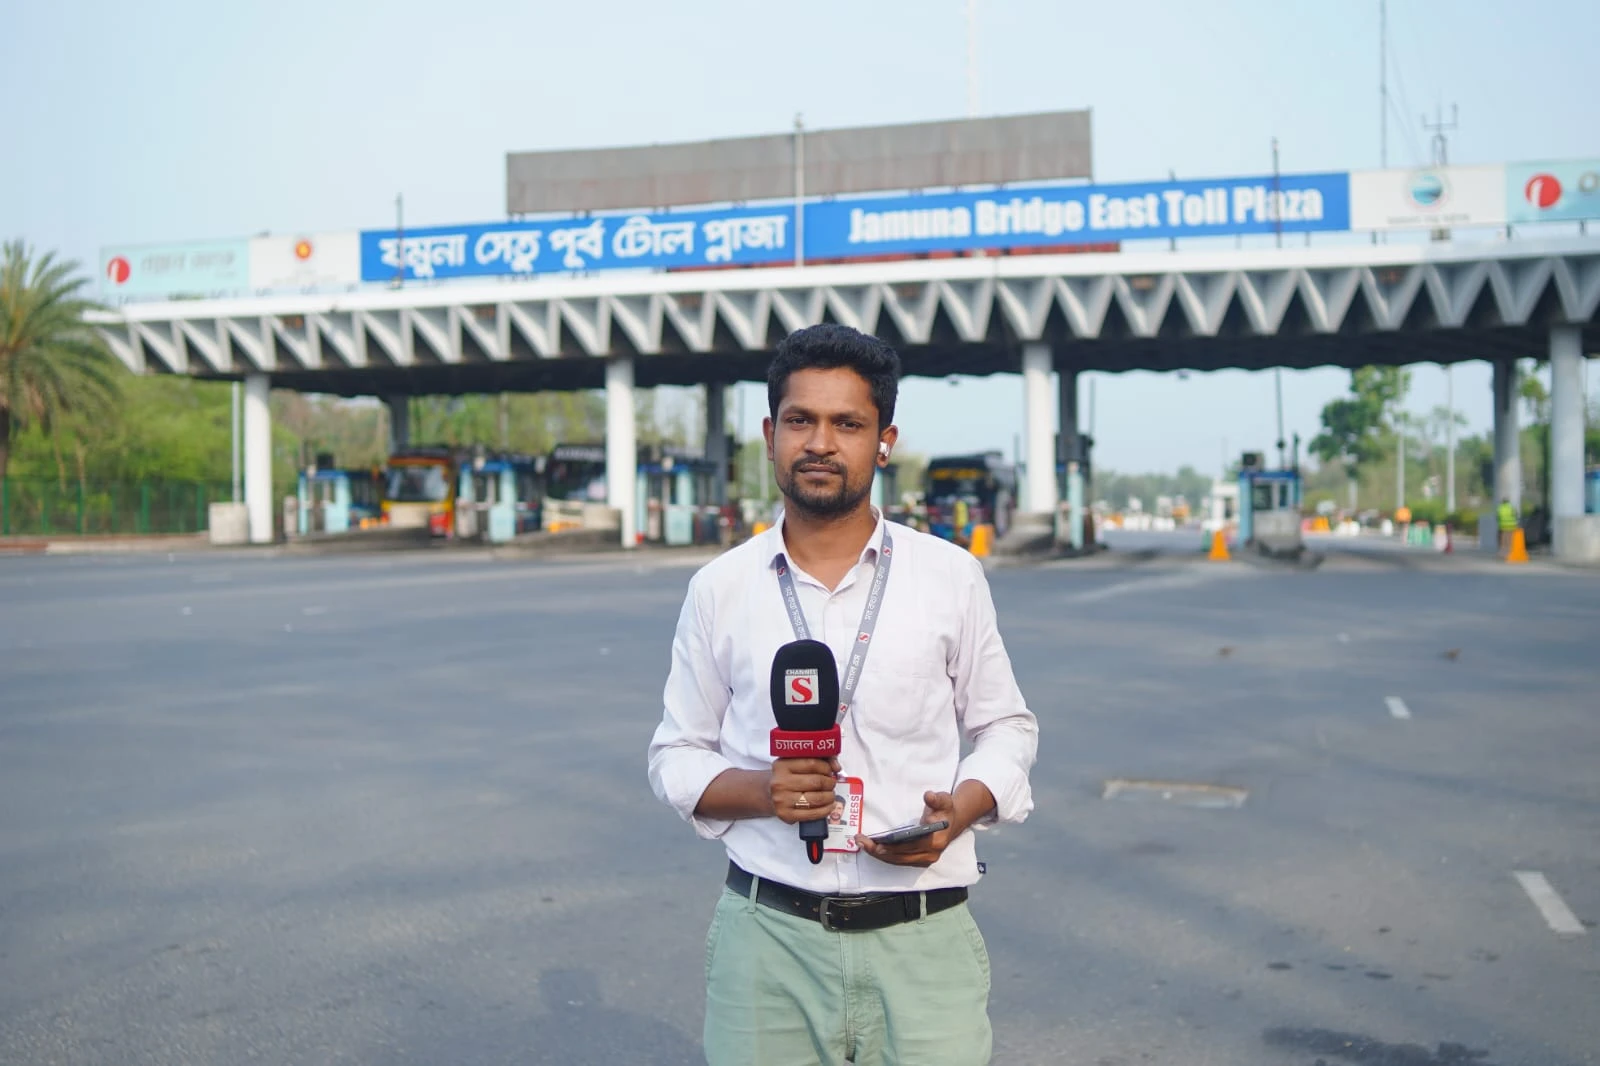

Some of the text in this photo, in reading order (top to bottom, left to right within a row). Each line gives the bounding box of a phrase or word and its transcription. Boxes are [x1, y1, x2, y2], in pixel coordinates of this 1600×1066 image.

[848, 185, 1323, 243] Jamuna Bridge East Toll Plaza
[378, 214, 788, 277] যমুনা সেতু পূর্ব টোল প্লাজা
[791, 677, 813, 703] S
[775, 738, 835, 751] চ্যানেল এস
[849, 795, 860, 827] PRESS
